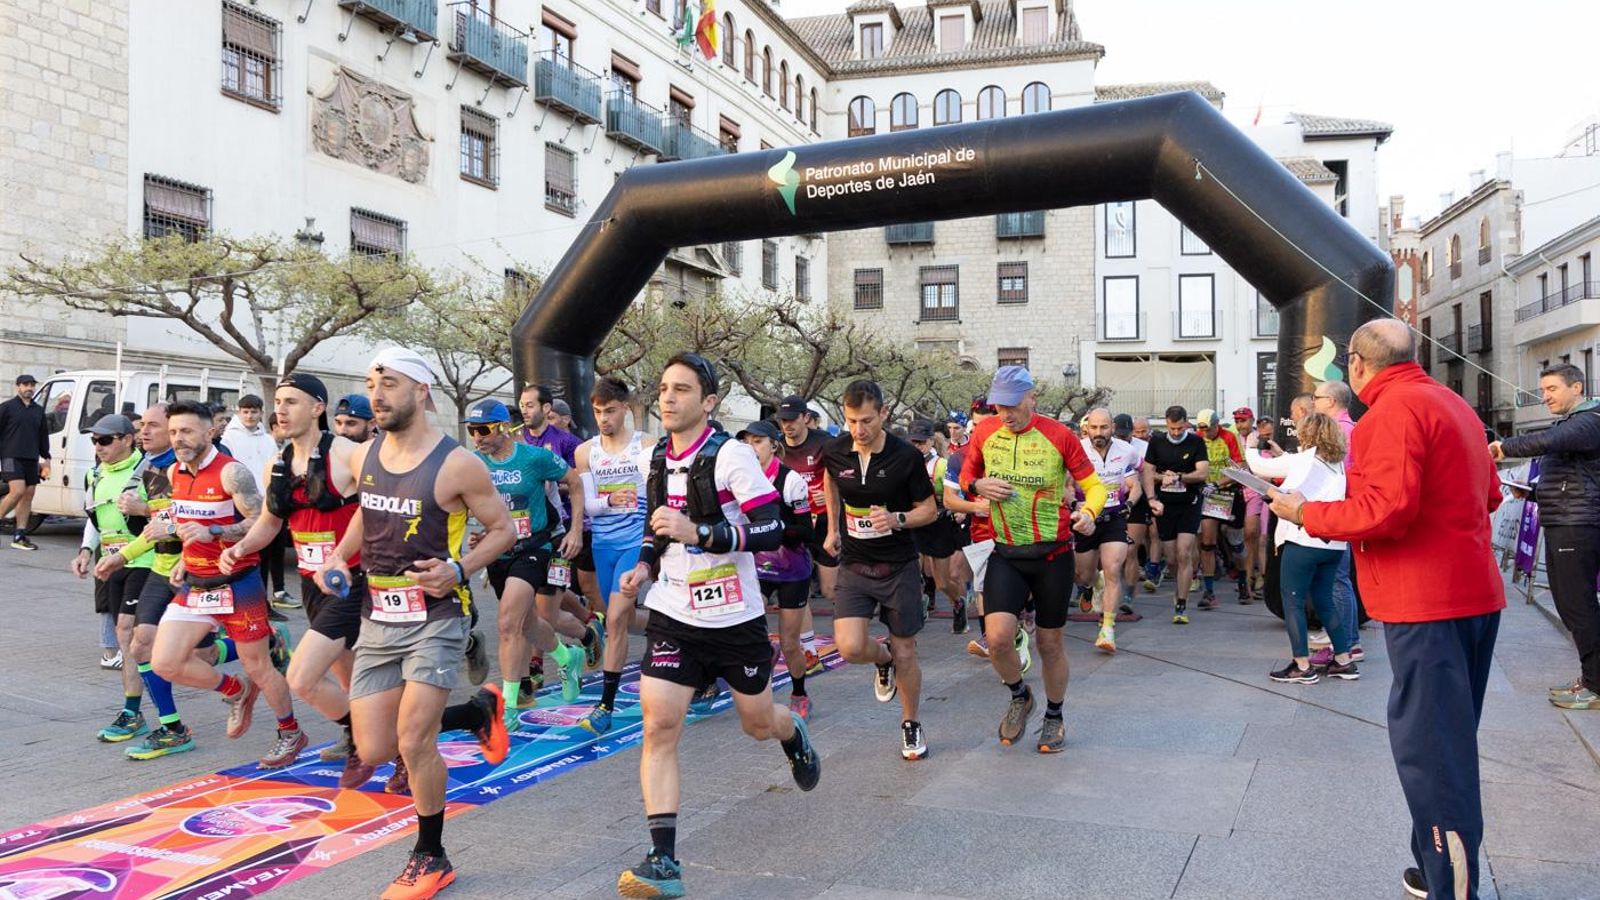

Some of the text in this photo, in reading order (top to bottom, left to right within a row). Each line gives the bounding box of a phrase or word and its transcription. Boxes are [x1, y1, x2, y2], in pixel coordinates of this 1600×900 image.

[805, 147, 976, 181] Patronato Municipal de
[806, 170, 936, 199] Deportes de Jaén
[595, 464, 639, 477] MARACENA
[361, 491, 417, 515] REDOLAT
[178, 505, 216, 516] Avanza
[858, 520, 873, 528] 60
[307, 549, 314, 559] 7
[200, 593, 220, 603] 164
[384, 594, 401, 607] 19
[694, 586, 723, 602] 121
[112, 778, 221, 813] TEAMERGY
